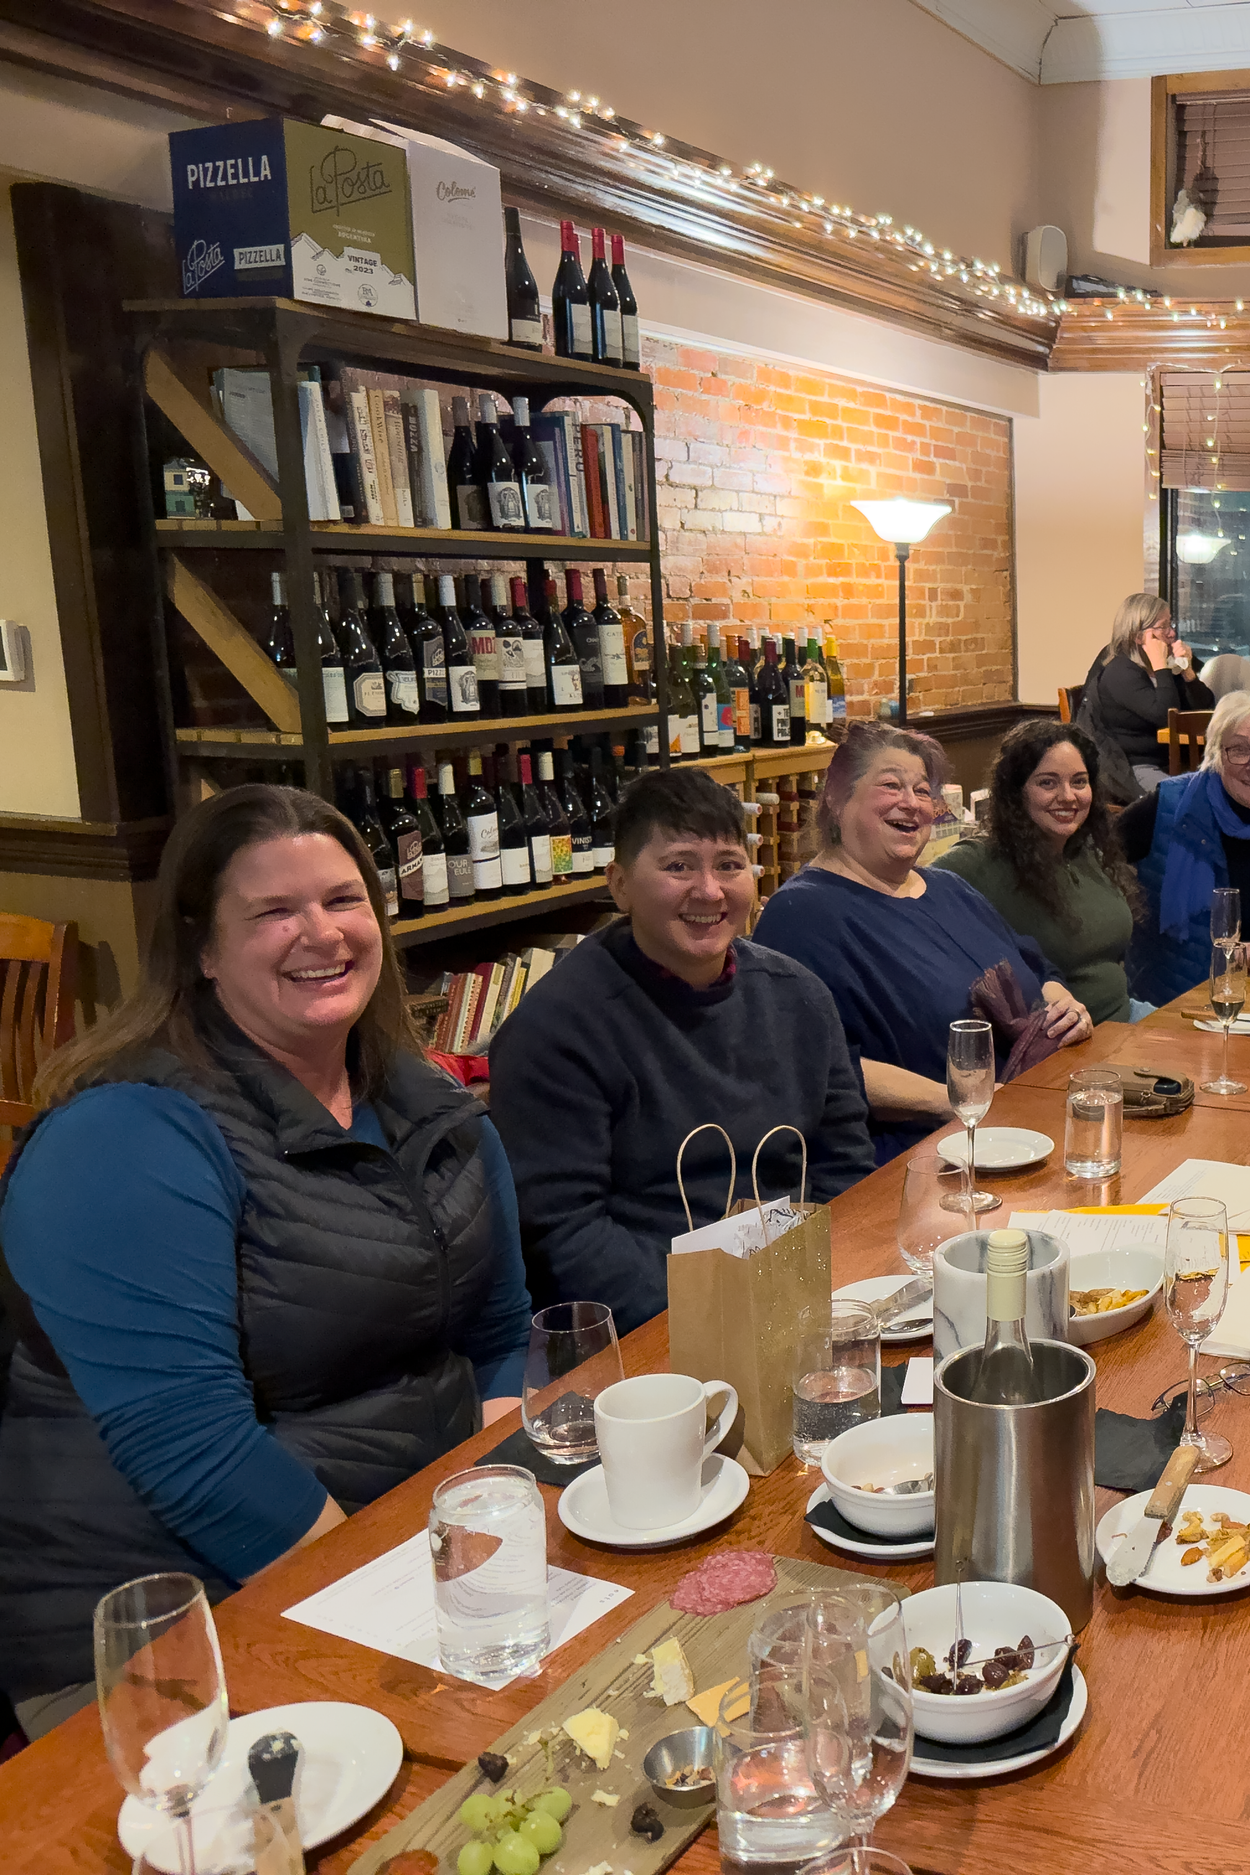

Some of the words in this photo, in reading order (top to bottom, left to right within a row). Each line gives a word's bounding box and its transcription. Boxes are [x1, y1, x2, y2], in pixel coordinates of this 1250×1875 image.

[187, 155, 272, 189] PIZZELLA
[321, 145, 391, 216] Posta
[187, 239, 225, 292] Posta
[238, 248, 282, 265] PIZZELLA
[347, 255, 378, 267] VINTAGE
[353, 265, 374, 275] 2023
[373, 394, 385, 444] CookWise
[572, 422, 584, 472] PERU
[447, 859, 468, 869] OUR
